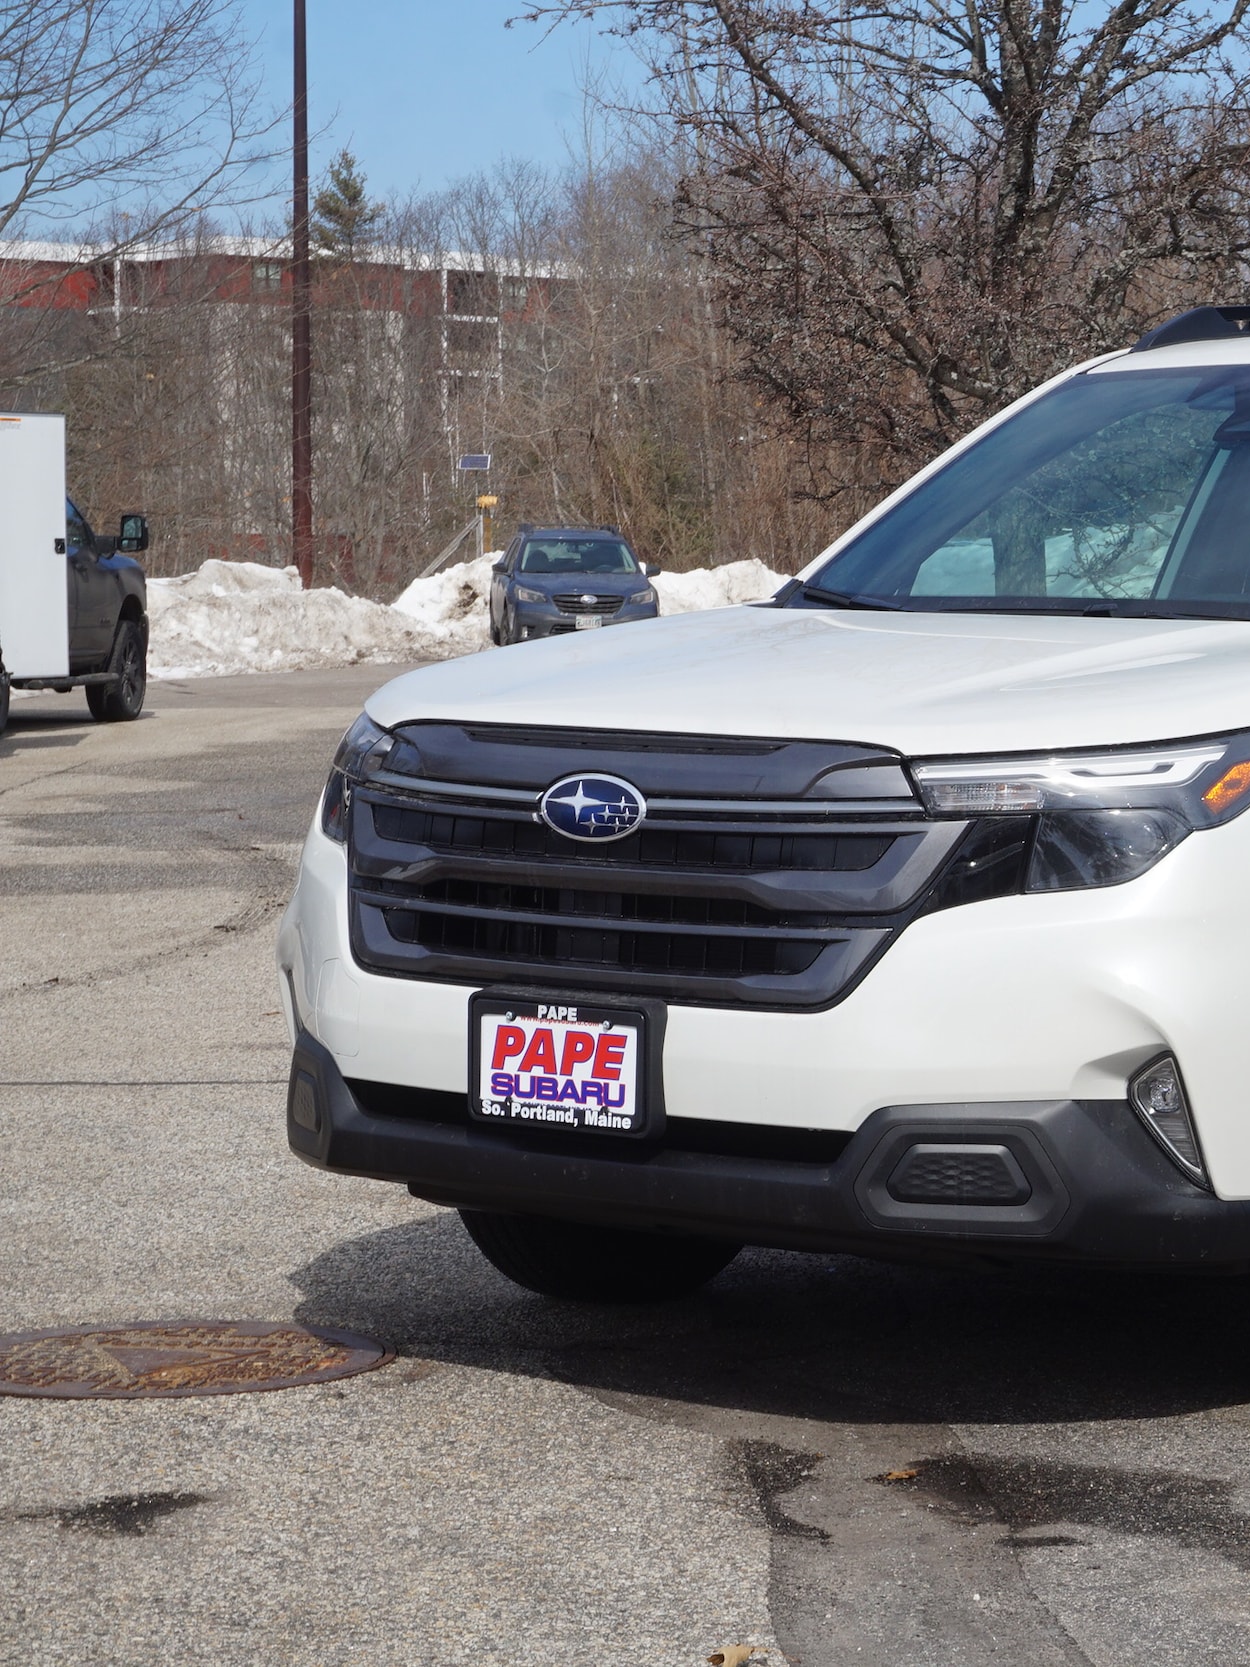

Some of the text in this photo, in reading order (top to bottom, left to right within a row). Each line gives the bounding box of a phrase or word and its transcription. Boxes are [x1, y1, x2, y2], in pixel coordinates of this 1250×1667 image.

[537, 1004, 578, 1022] PAPE
[491, 1024, 628, 1080] PAPE
[491, 1072, 626, 1108] SUBARU
[481, 1100, 505, 1116] So.
[511, 1102, 578, 1127] Portland,
[584, 1110, 632, 1131] Maine
